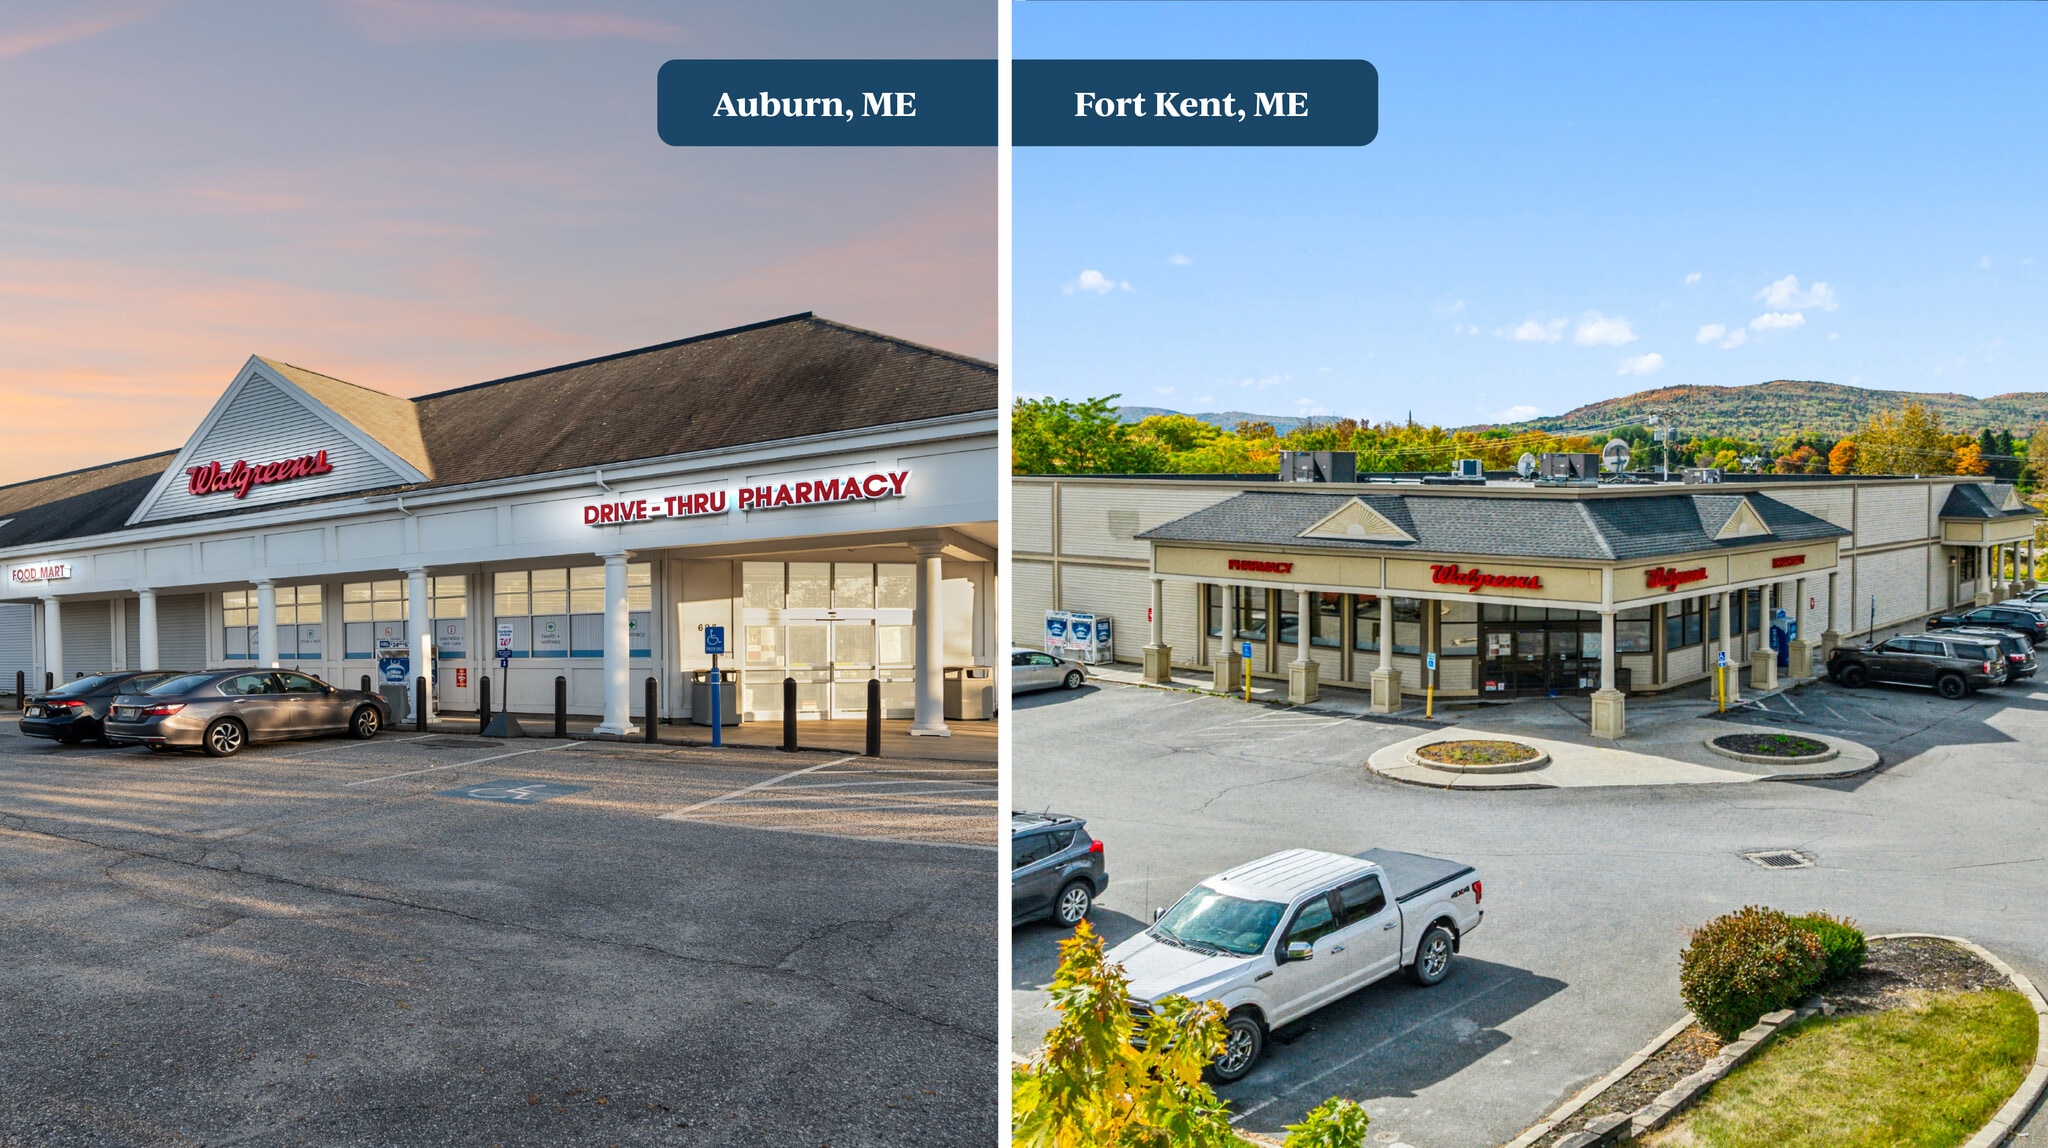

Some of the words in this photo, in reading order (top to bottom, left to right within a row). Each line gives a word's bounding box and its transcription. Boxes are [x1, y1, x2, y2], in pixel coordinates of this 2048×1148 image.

[186, 450, 333, 499] Walgreens
[738, 470, 910, 509] PHARMACY
[12, 567, 37, 582] FOOD
[40, 564, 65, 579] MART
[1228, 559, 1294, 574] PHARMACY
[1430, 564, 1544, 593] Walgreens
